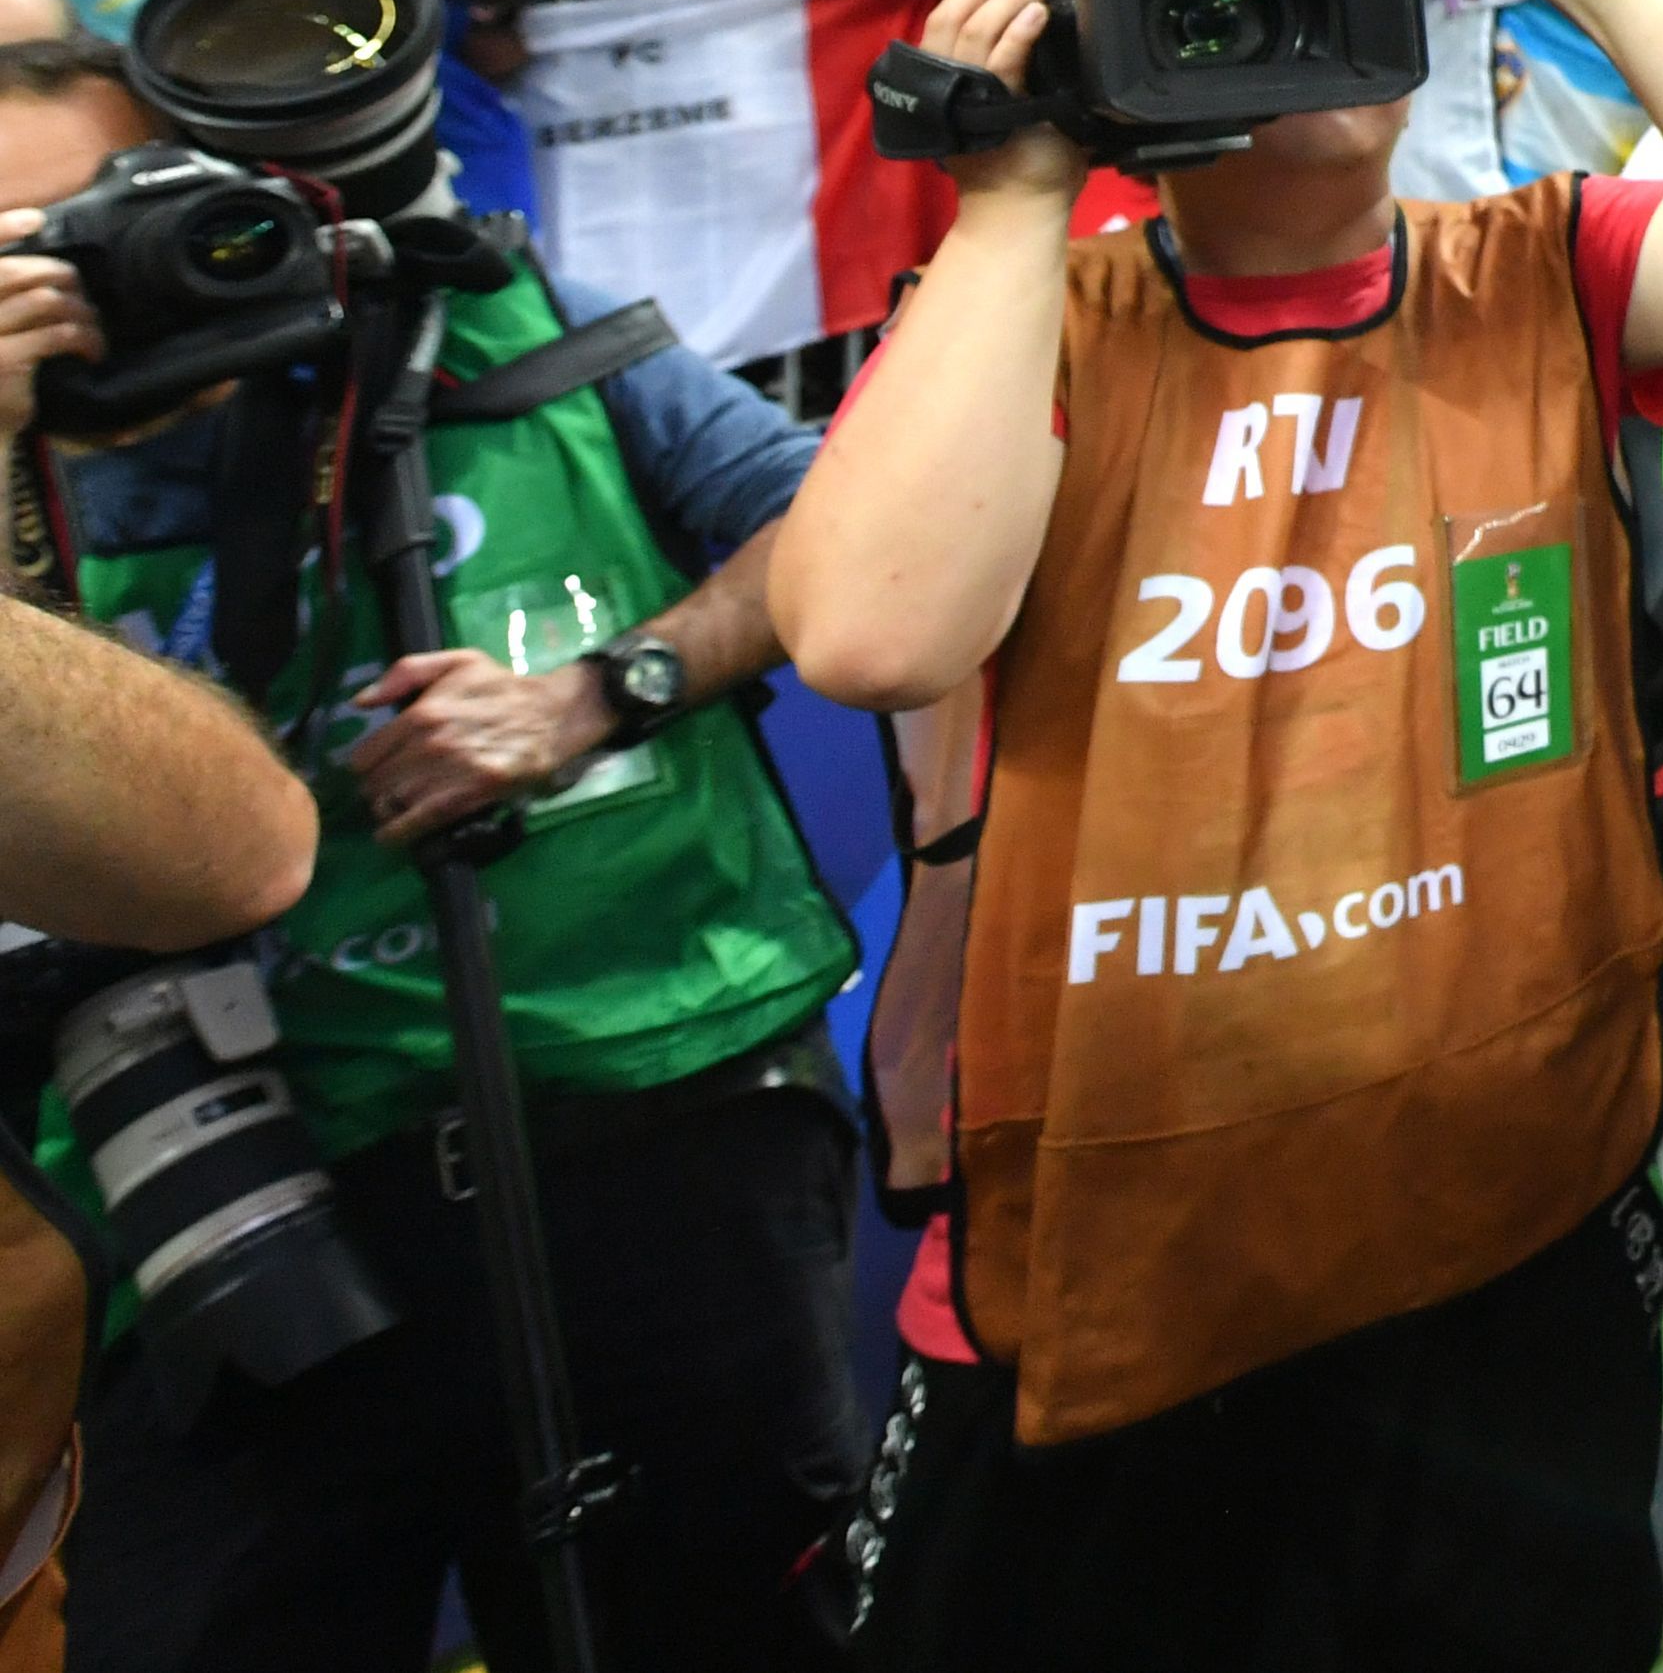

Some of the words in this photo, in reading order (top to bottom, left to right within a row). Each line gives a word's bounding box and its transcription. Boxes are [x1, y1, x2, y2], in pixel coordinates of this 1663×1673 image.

[873, 80, 919, 113] SONY
[1115, 543, 1425, 684] 2096
[1478, 615, 1549, 652] FIELD
[1486, 668, 1546, 720] 64
